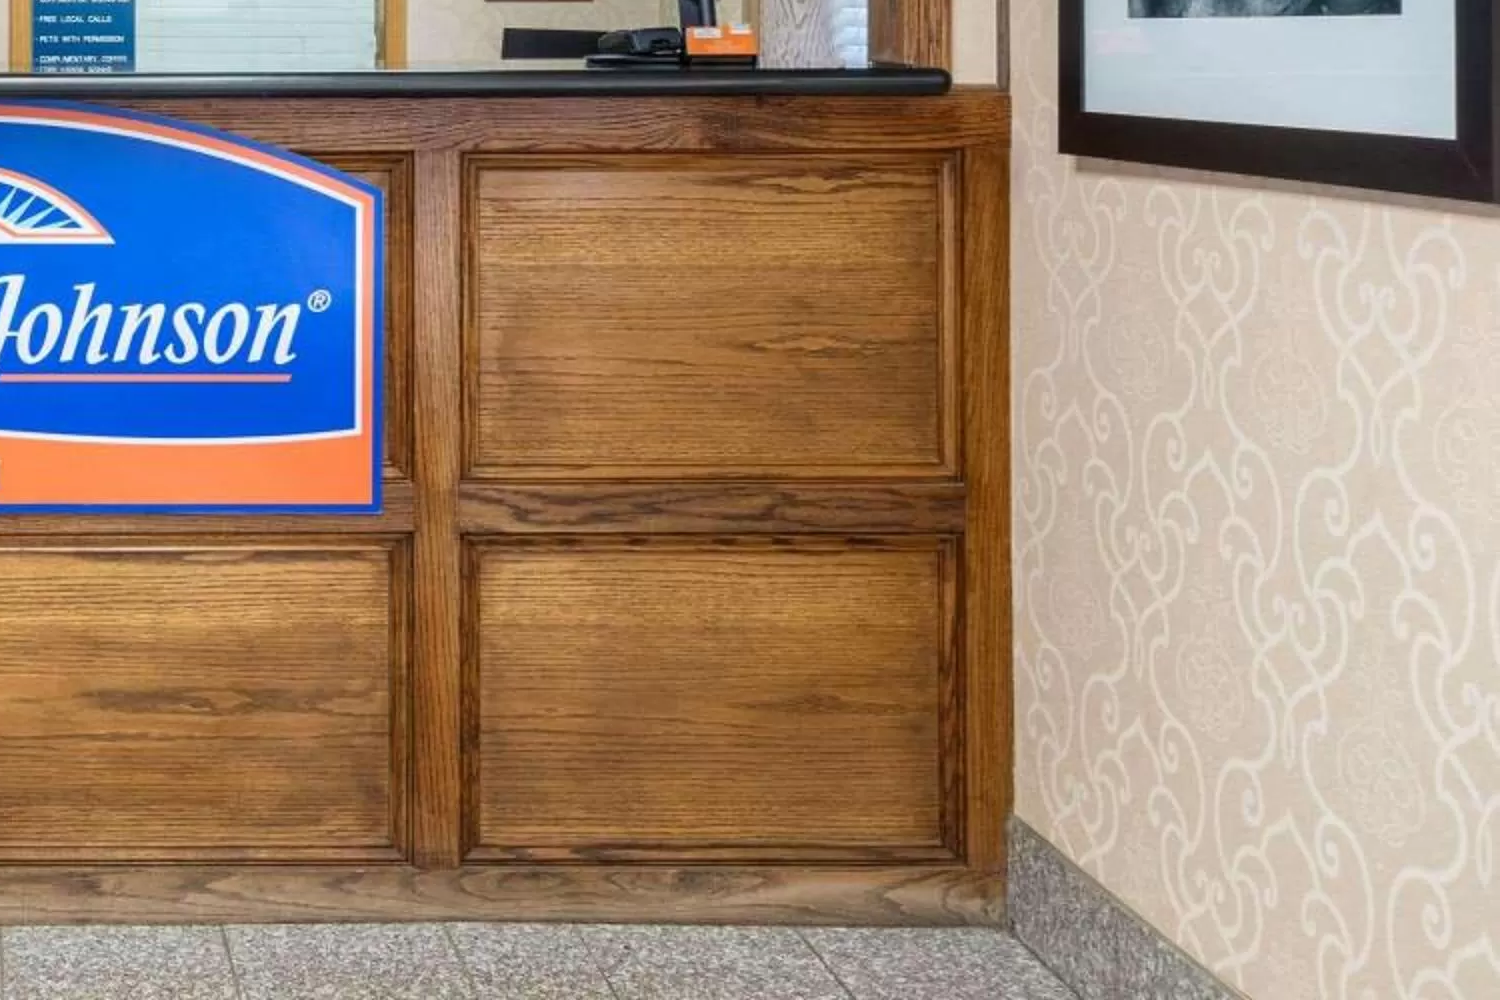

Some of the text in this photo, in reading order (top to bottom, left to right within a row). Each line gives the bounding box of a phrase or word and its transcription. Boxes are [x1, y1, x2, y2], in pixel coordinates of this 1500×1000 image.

[39, 15, 112, 23] FREE LOCAL CALLS
[39, 35, 125, 43] PETS WITH PERMISSION
